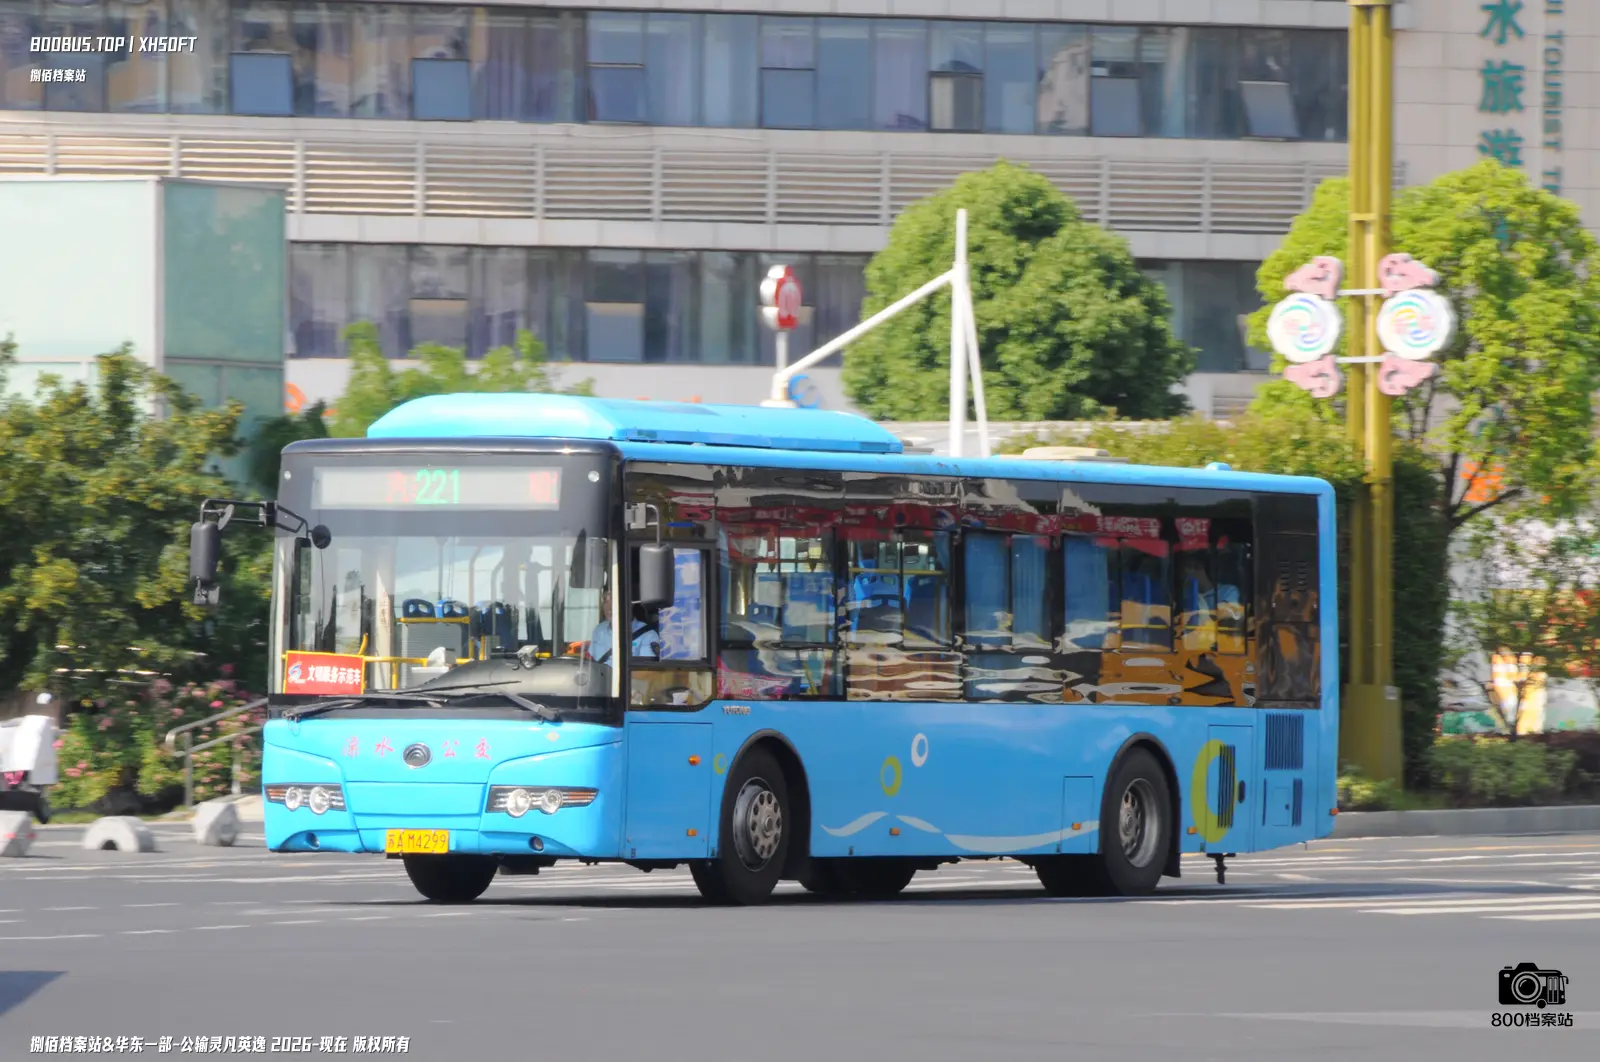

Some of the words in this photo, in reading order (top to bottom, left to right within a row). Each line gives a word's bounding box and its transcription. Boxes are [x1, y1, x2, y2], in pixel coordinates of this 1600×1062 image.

[1543, 30, 1564, 152] TOURIST
[415, 469, 460, 504] 221
[441, 737, 491, 760] 公交
